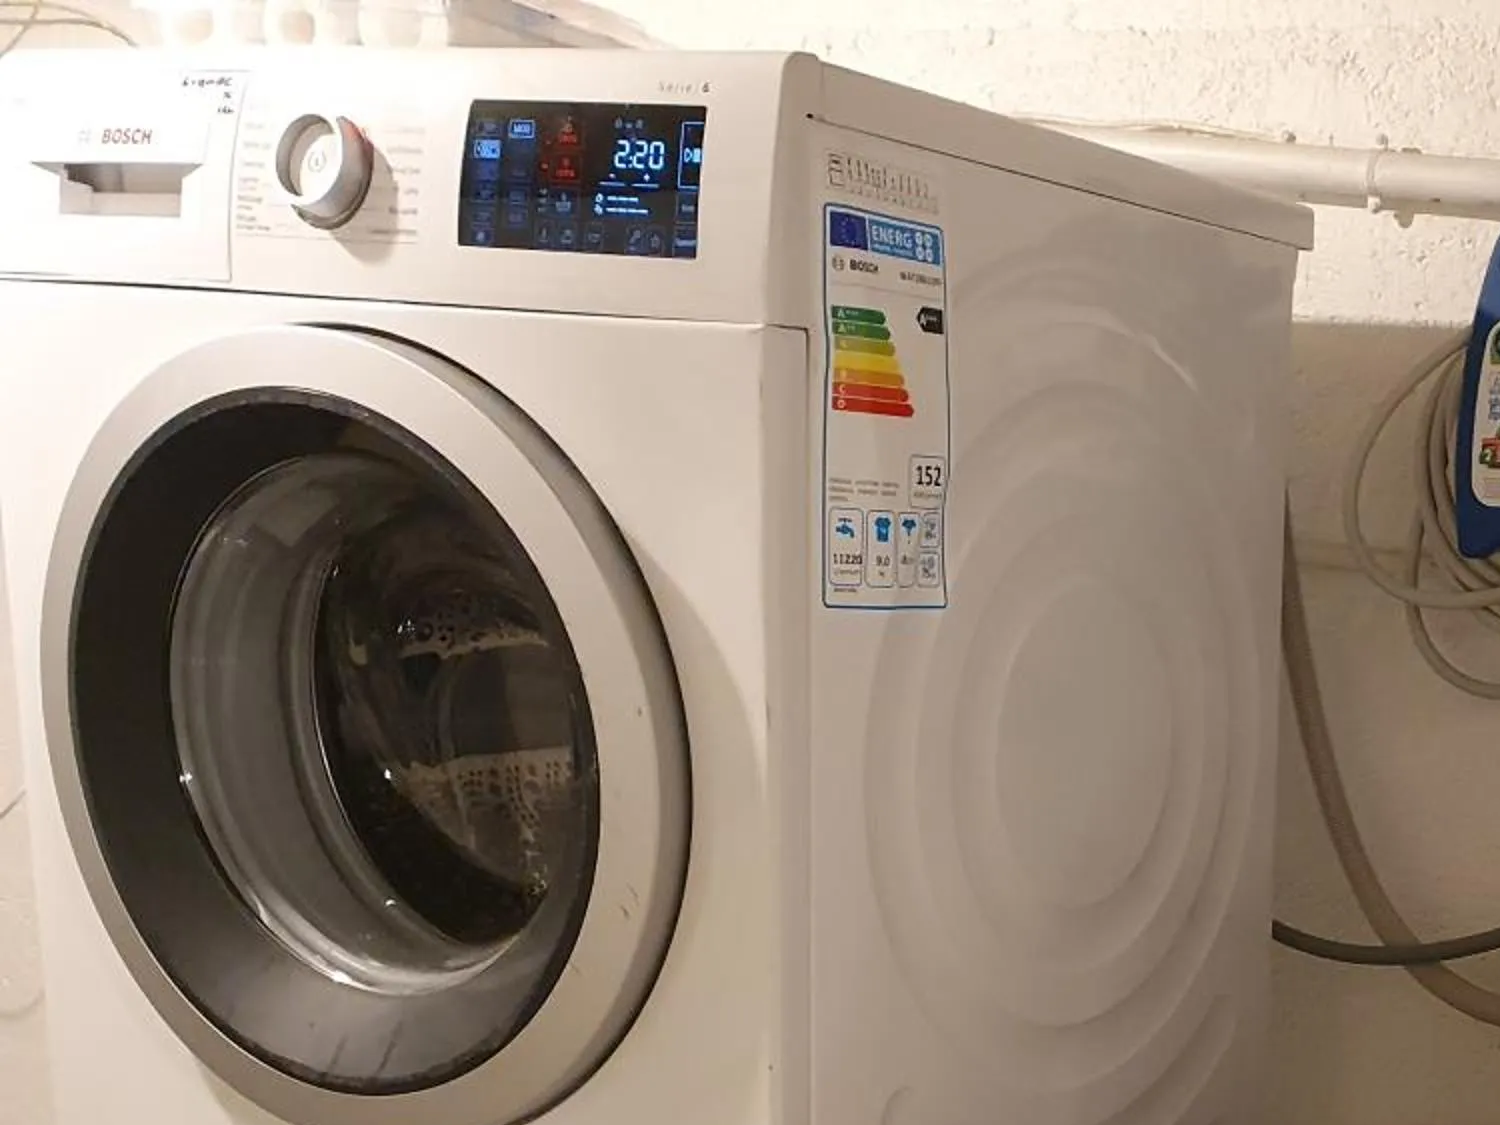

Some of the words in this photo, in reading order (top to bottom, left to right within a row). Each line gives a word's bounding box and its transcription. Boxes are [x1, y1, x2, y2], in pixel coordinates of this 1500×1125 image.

[101, 128, 153, 145] BOSCH
[613, 138, 666, 170] 2:20
[871, 225, 914, 249] ENERG
[915, 464, 942, 487] 152
[833, 553, 863, 565] 11220
